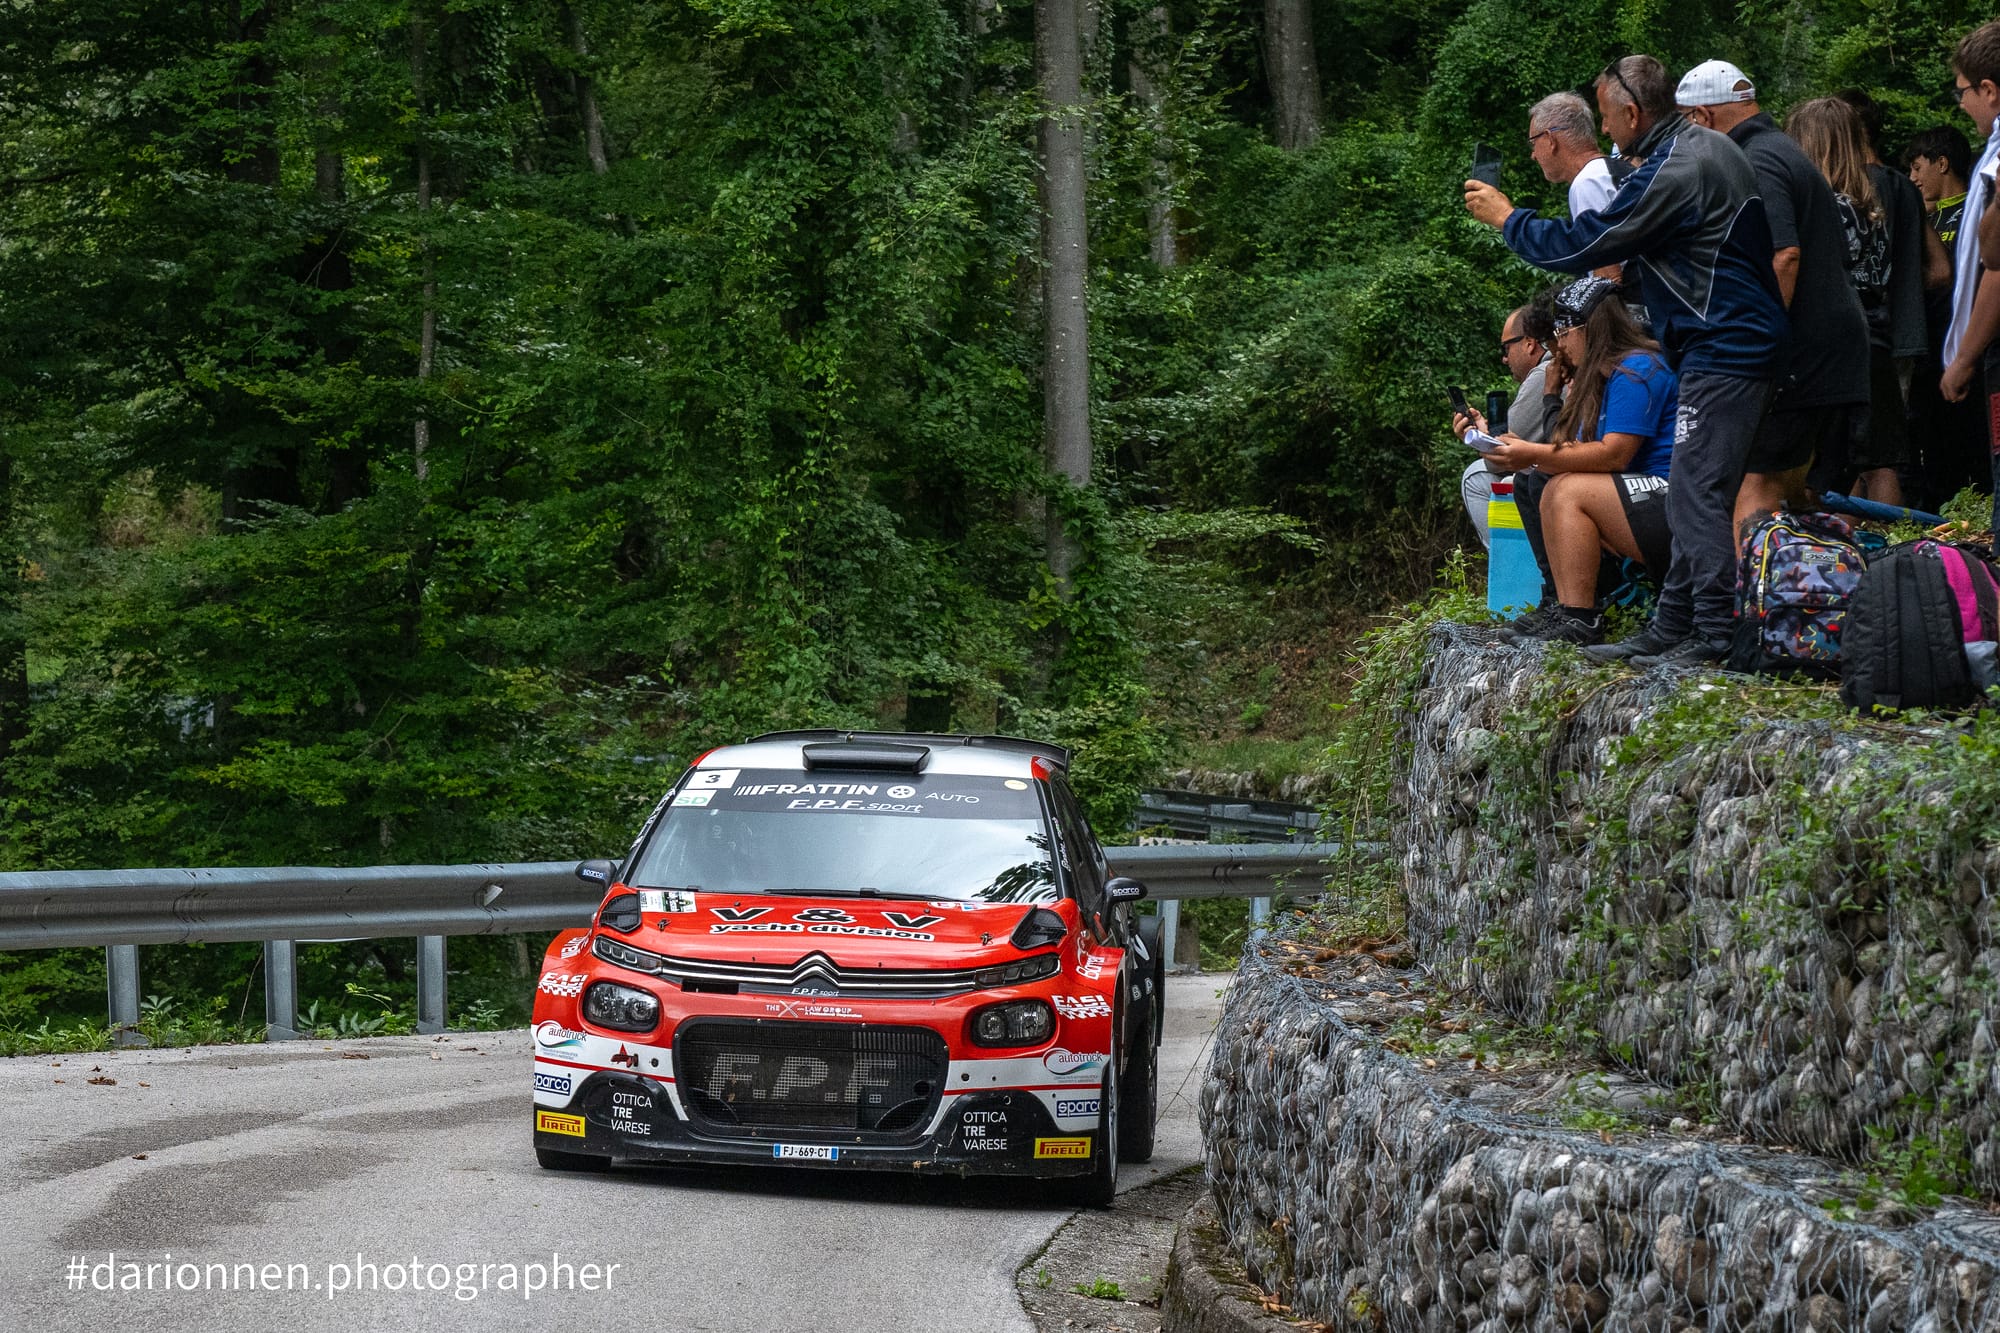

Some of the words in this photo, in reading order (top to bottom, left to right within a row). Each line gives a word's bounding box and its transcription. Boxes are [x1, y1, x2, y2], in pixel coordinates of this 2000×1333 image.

[705, 774, 721, 784] 3
[676, 796, 708, 805] SD
[758, 784, 879, 796] FRATTIN
[925, 792, 980, 804] AUTO
[711, 908, 774, 922] V
[792, 908, 857, 923] &
[881, 911, 946, 929] V
[709, 923, 804, 934] yacht
[808, 924, 935, 941] division
[766, 1004, 780, 1012] THE
[548, 1027, 588, 1041] autotruck
[1058, 1050, 1103, 1063] autotruck
[612, 1092, 652, 1108] OTTICA
[612, 1105, 633, 1119] TRE
[963, 1111, 1007, 1123] OTTICA
[541, 1114, 581, 1133] PIRELLI
[610, 1119, 651, 1135] VARESE
[963, 1126, 986, 1137] TRE
[963, 1138, 1008, 1150] VARESE
[1039, 1141, 1087, 1155] PIRELLI
